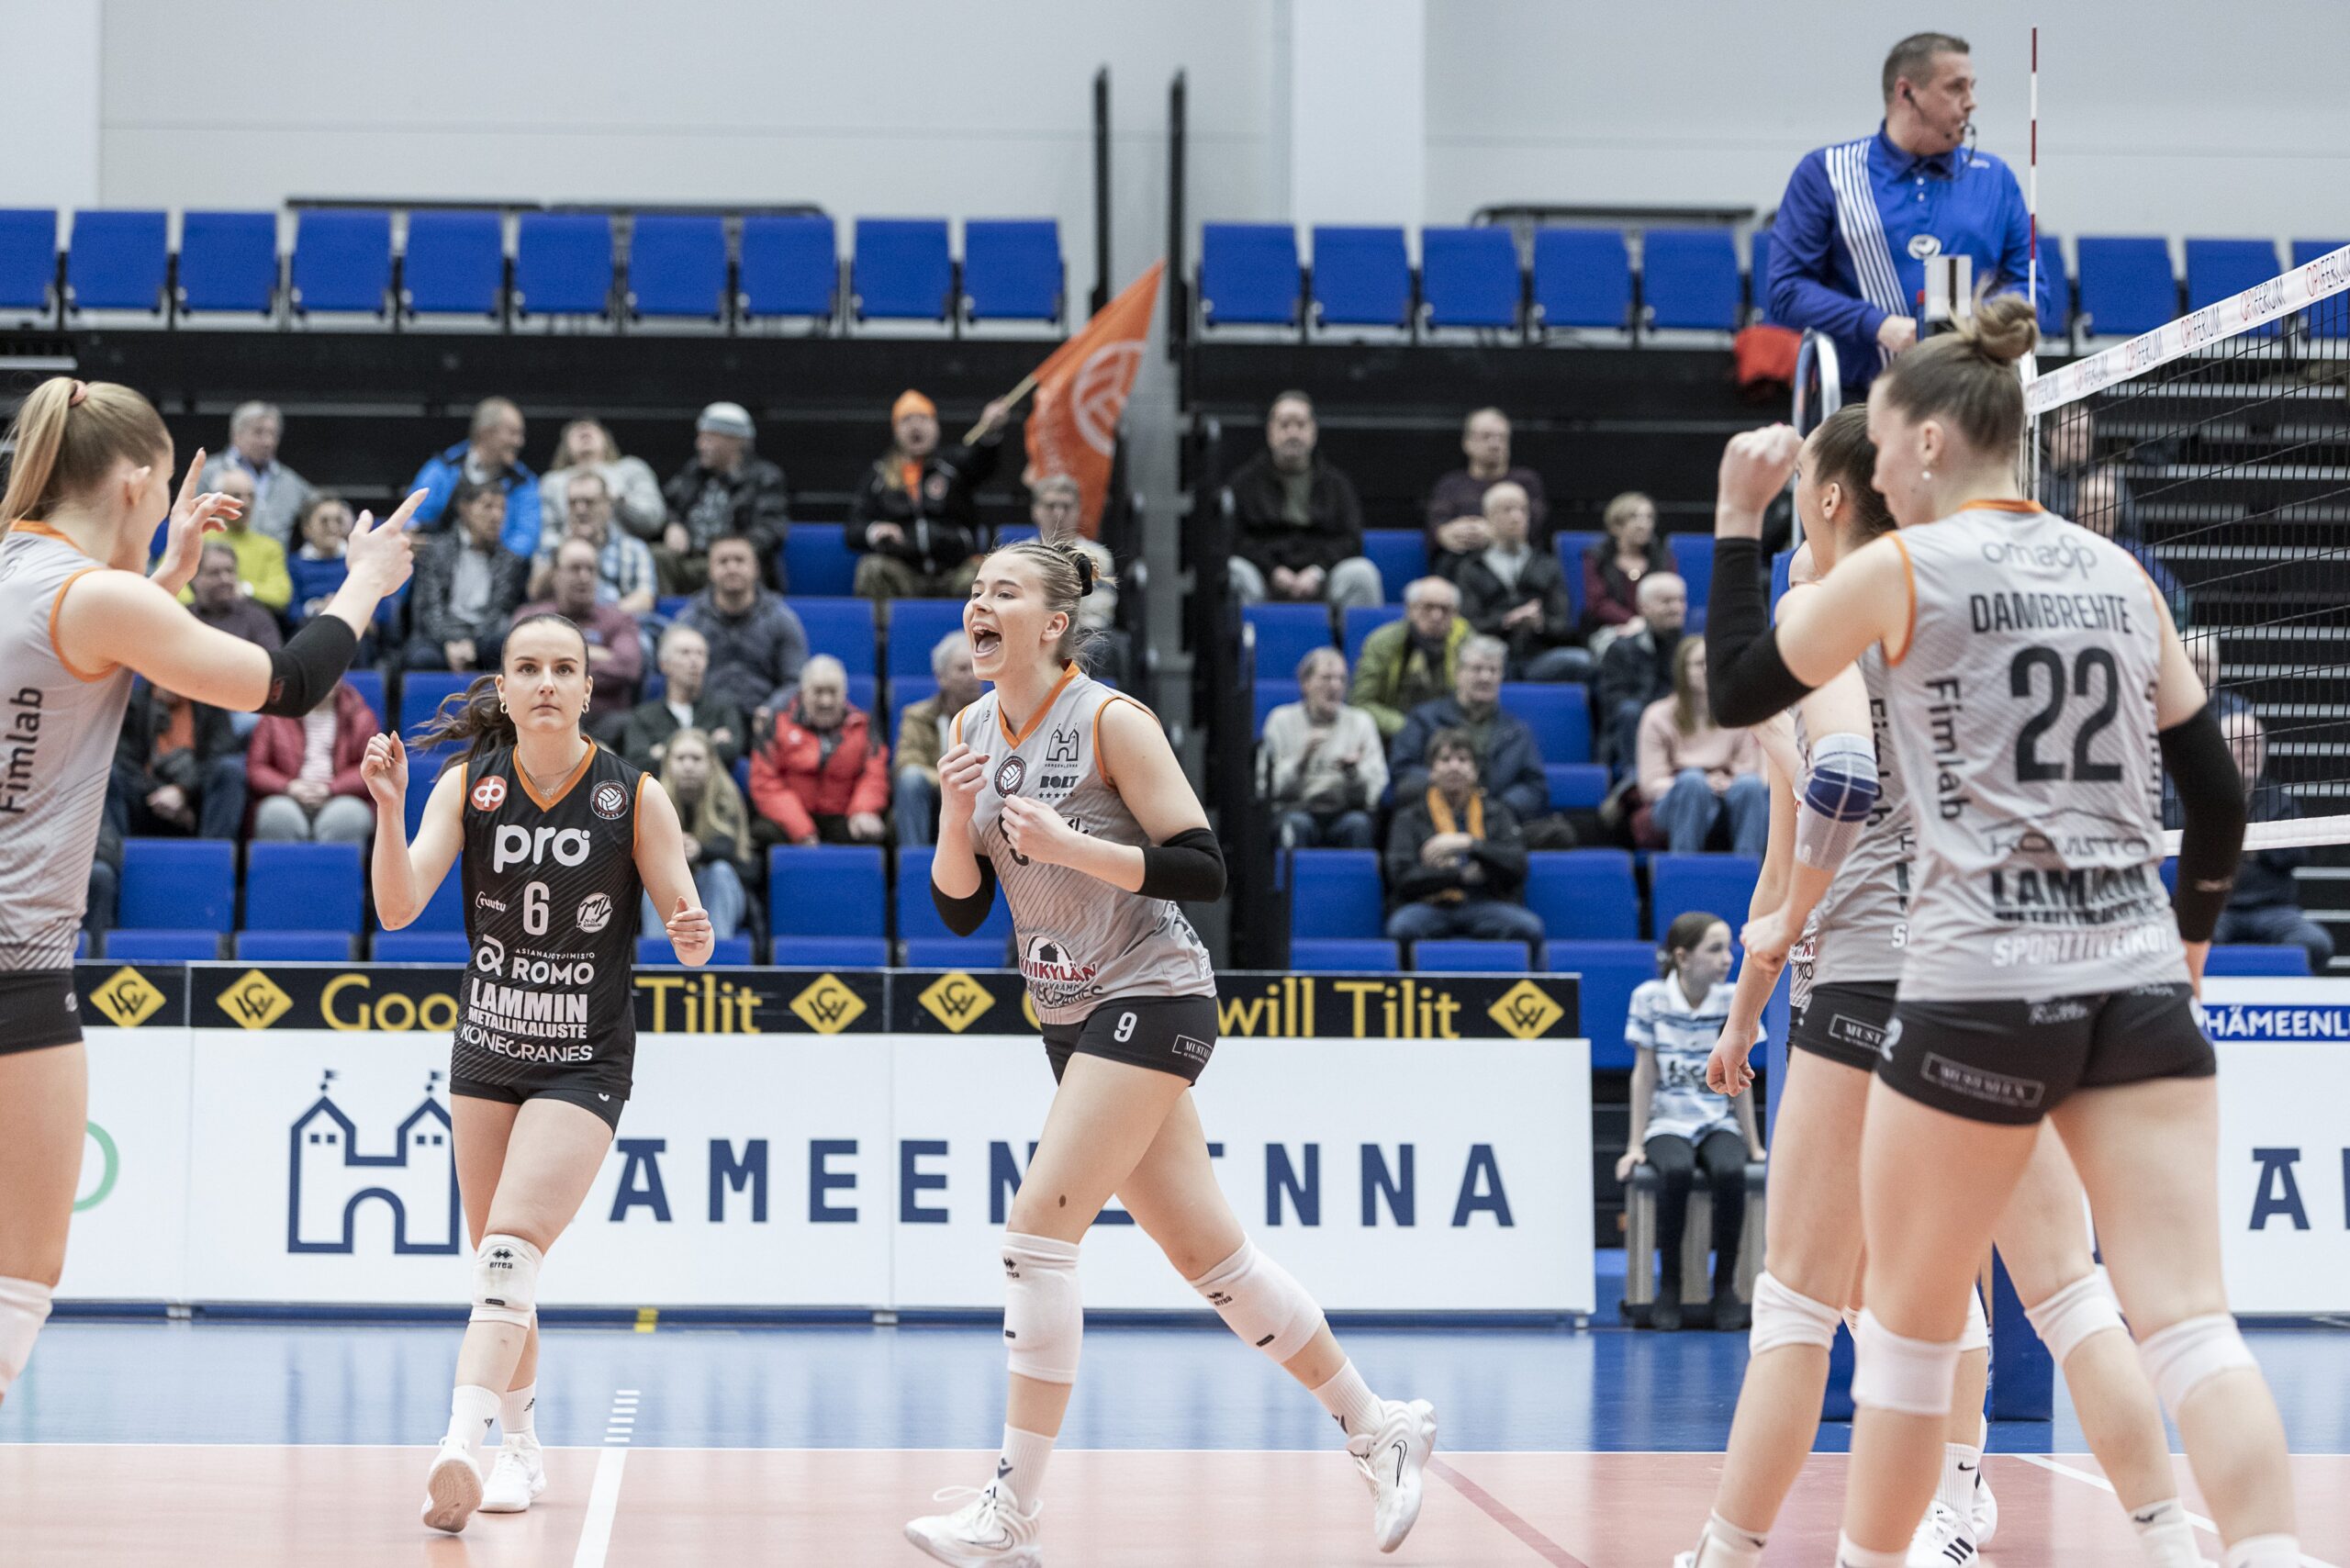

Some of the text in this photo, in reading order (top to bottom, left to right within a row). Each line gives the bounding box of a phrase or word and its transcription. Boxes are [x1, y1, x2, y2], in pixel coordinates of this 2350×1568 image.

[2010, 646, 2123, 783] 22
[0, 687, 44, 815] Fimlab
[1926, 677, 1972, 821] Fimlab
[1039, 776, 1080, 789] BOLT
[494, 824, 590, 874] pro
[477, 896, 507, 913] ruutu
[523, 881, 550, 935] 6
[511, 957, 595, 985] ROMO
[468, 1006, 588, 1039] METALLIKALUSTE
[469, 978, 588, 1023] LAMMIN
[634, 974, 762, 1034] Tilit
[1334, 979, 1461, 1039] Tilit
[2207, 1006, 2350, 1038] HÄMEENL
[460, 1024, 594, 1063] KONECRANES
[1113, 1012, 1137, 1043] 9
